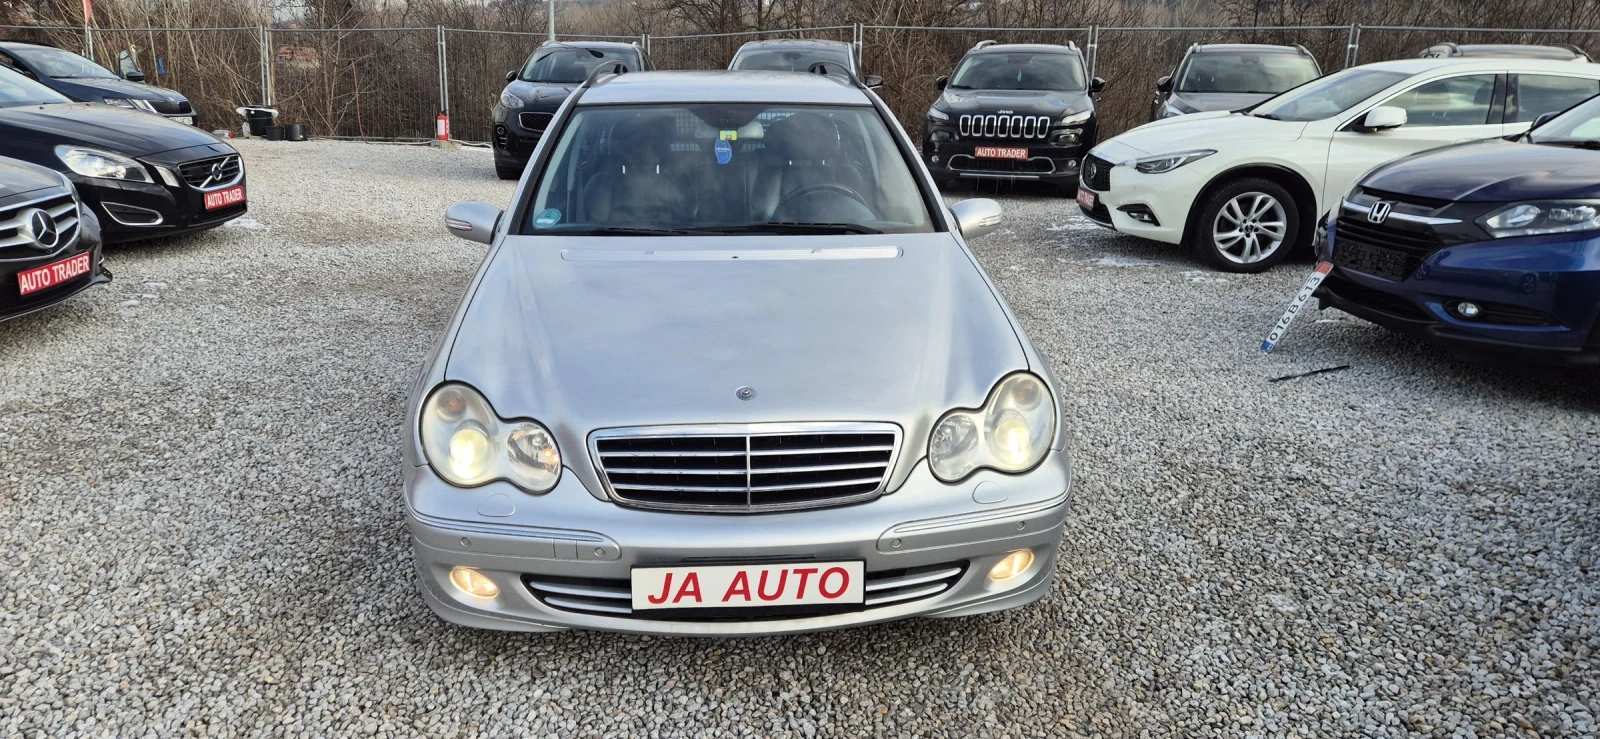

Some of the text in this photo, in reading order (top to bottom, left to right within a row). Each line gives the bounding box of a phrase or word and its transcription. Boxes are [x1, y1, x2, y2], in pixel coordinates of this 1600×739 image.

[976, 148, 1026, 158] AUTO TRADER
[207, 188, 244, 207] AUTO TRADER
[20, 254, 90, 294] AUTO TRADER
[647, 566, 850, 604] JA AUTO
